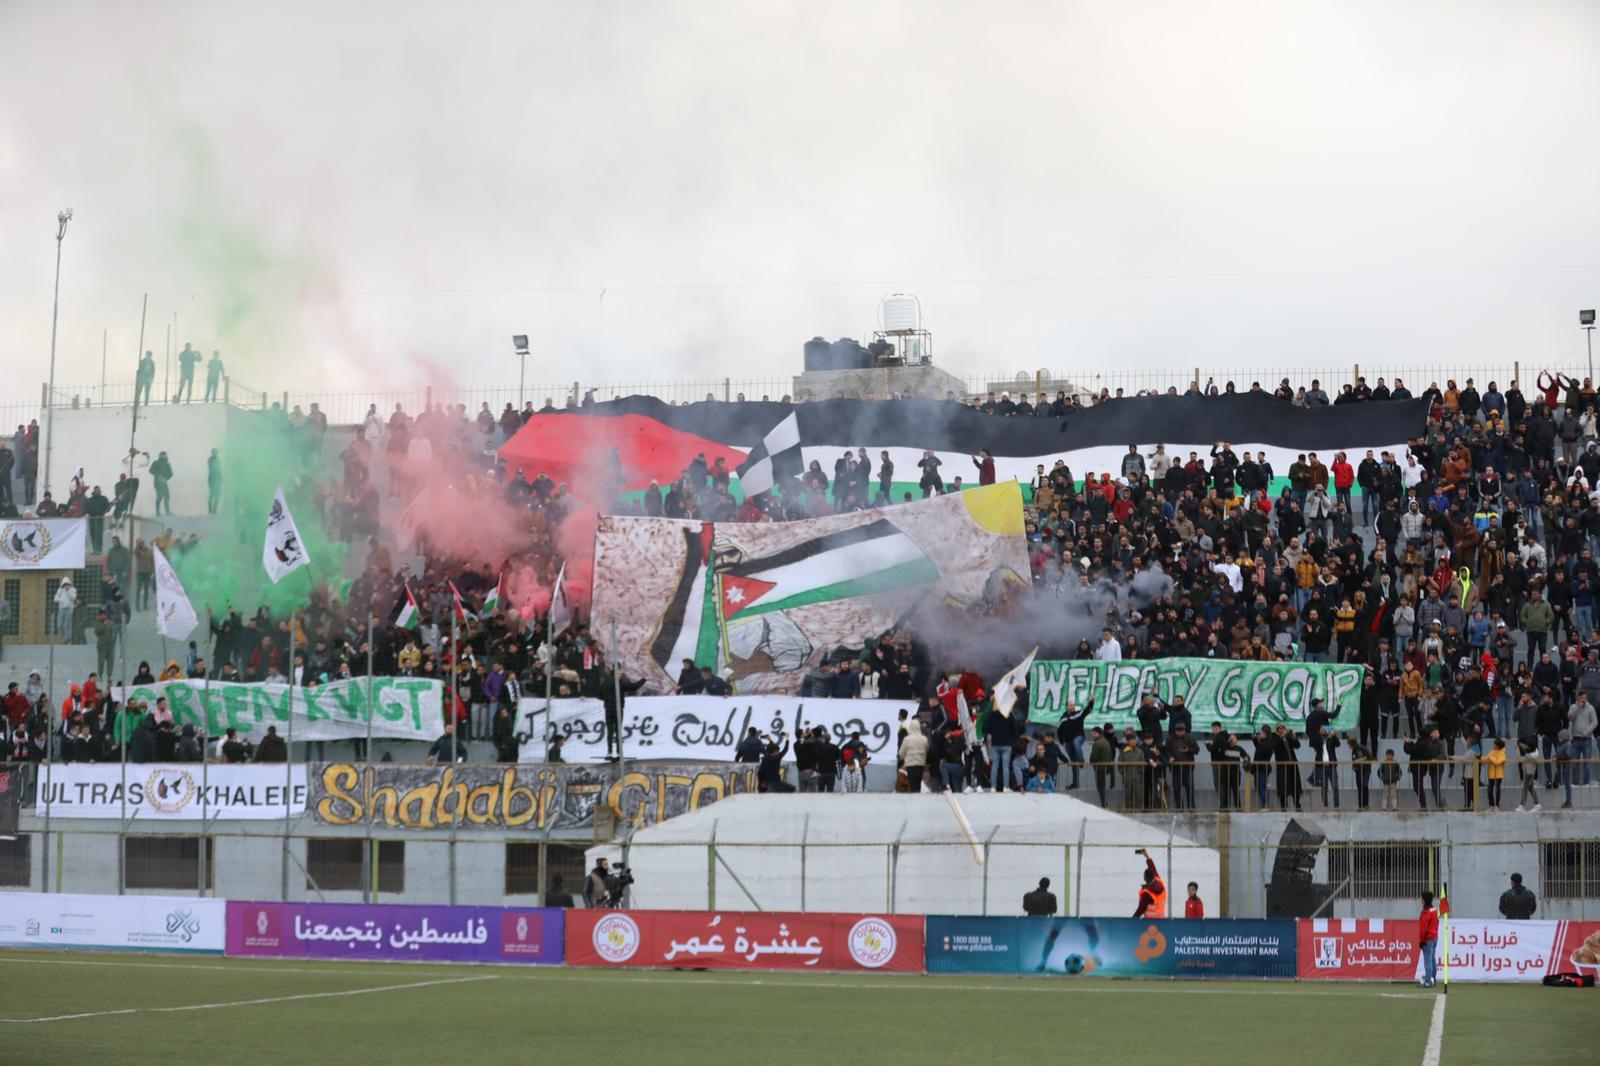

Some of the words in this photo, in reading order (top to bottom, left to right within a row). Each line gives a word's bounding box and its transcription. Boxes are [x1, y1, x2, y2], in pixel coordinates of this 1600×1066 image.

[1215, 667, 1360, 724] GROUP
[671, 705, 753, 752] المدرج
[41, 782, 144, 805] ULTRAS
[316, 762, 556, 829] Shababi
[294, 914, 382, 949] بتجمعنا
[389, 917, 488, 951] فلسطين
[1221, 934, 1258, 946] الاستثمار
[1174, 947, 1211, 955] PALESTINE
[1212, 947, 1257, 956] INVESTMENT
[1259, 948, 1279, 956] BANK
[1347, 939, 1386, 954] كنتاكي
[1388, 939, 1412, 953] دجاج
[1347, 953, 1411, 966] فلسطين
[1436, 952, 1475, 972] الخلي
[1481, 953, 1512, 972] دورا
[1516, 953, 1544, 974] في
